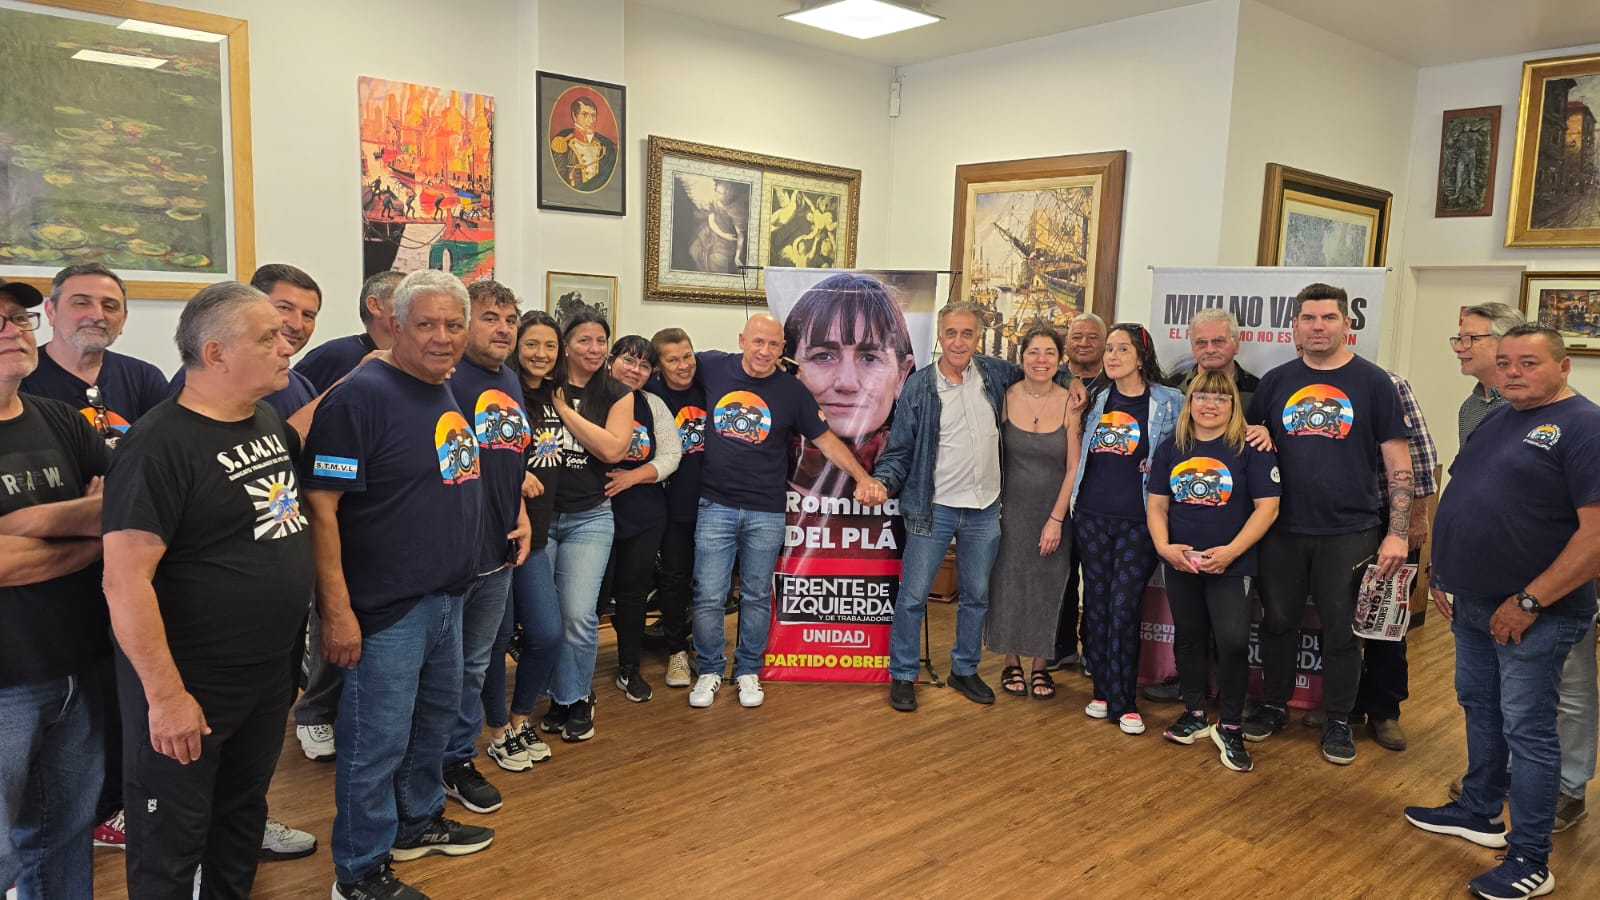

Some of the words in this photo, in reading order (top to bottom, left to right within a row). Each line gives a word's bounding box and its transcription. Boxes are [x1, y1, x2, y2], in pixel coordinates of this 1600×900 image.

[1229, 296, 1264, 328] NO
[1270, 296, 1367, 330] VAS
[1169, 327, 1182, 339] EL
[1257, 331, 1273, 343] NO
[1277, 332, 1292, 343] ES
[784, 525, 836, 549] DEL
[841, 520, 897, 550] PLÁ
[783, 576, 865, 597] FRENTE
[867, 583, 890, 597] DE
[782, 595, 895, 616] IZQUIERDA
[1364, 595, 1382, 630] GAZA
[802, 629, 865, 643] UNIDAD
[764, 654, 838, 668] PARTIDO
[839, 655, 891, 669] OBRER
[421, 833, 449, 843] FILA
